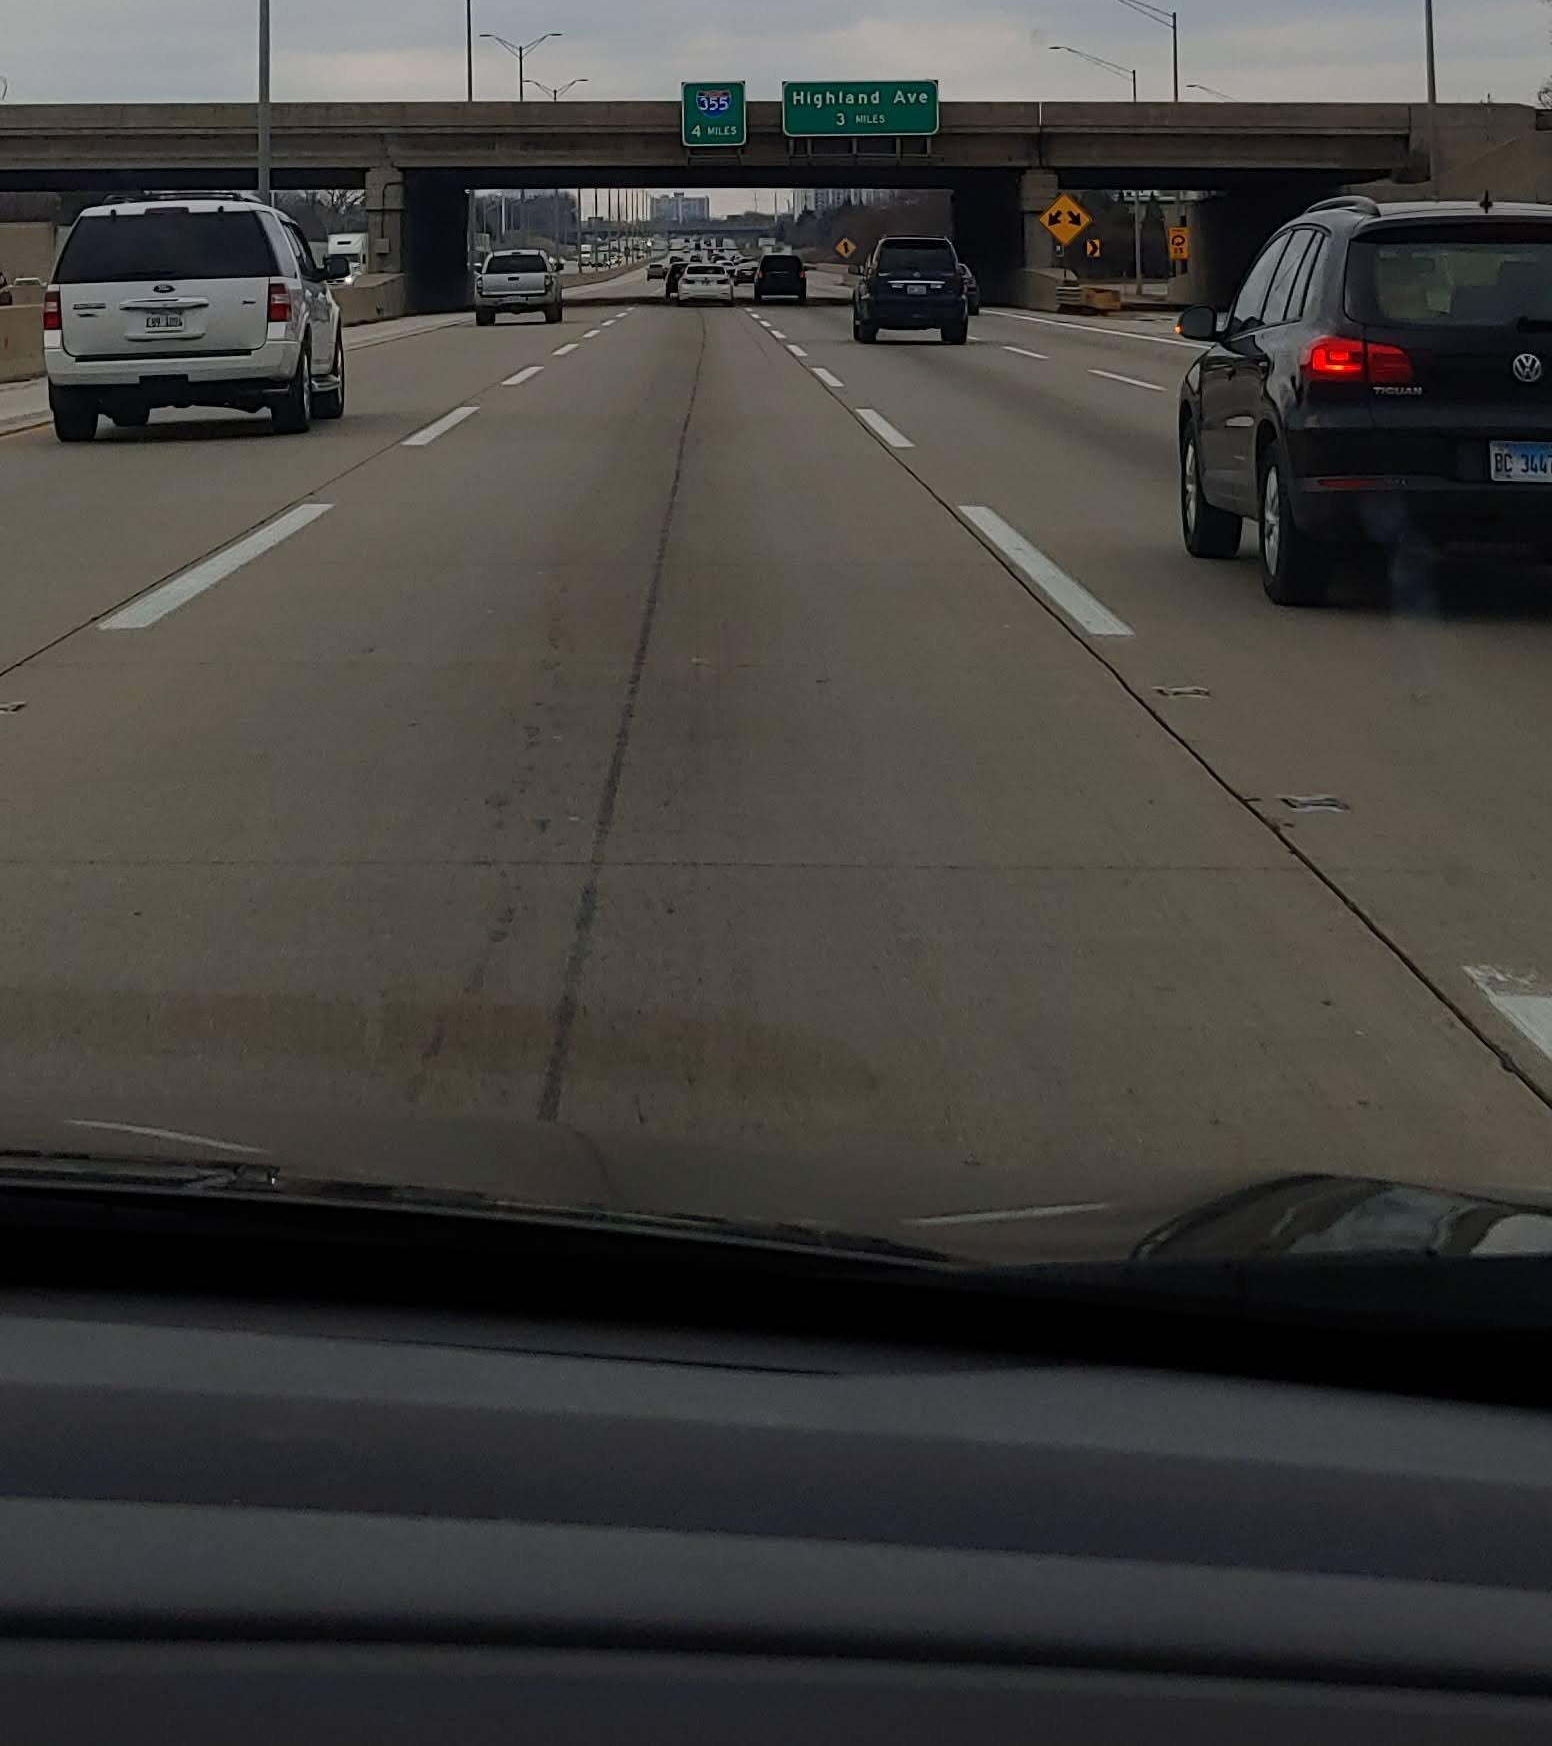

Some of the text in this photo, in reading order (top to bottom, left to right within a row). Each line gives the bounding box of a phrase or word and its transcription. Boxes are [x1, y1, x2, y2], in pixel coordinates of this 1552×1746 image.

[698, 96, 730, 111] 355
[792, 90, 929, 108] Highland Ave
[835, 113, 886, 126] 3 MILES
[691, 125, 737, 138] 4 MILES
